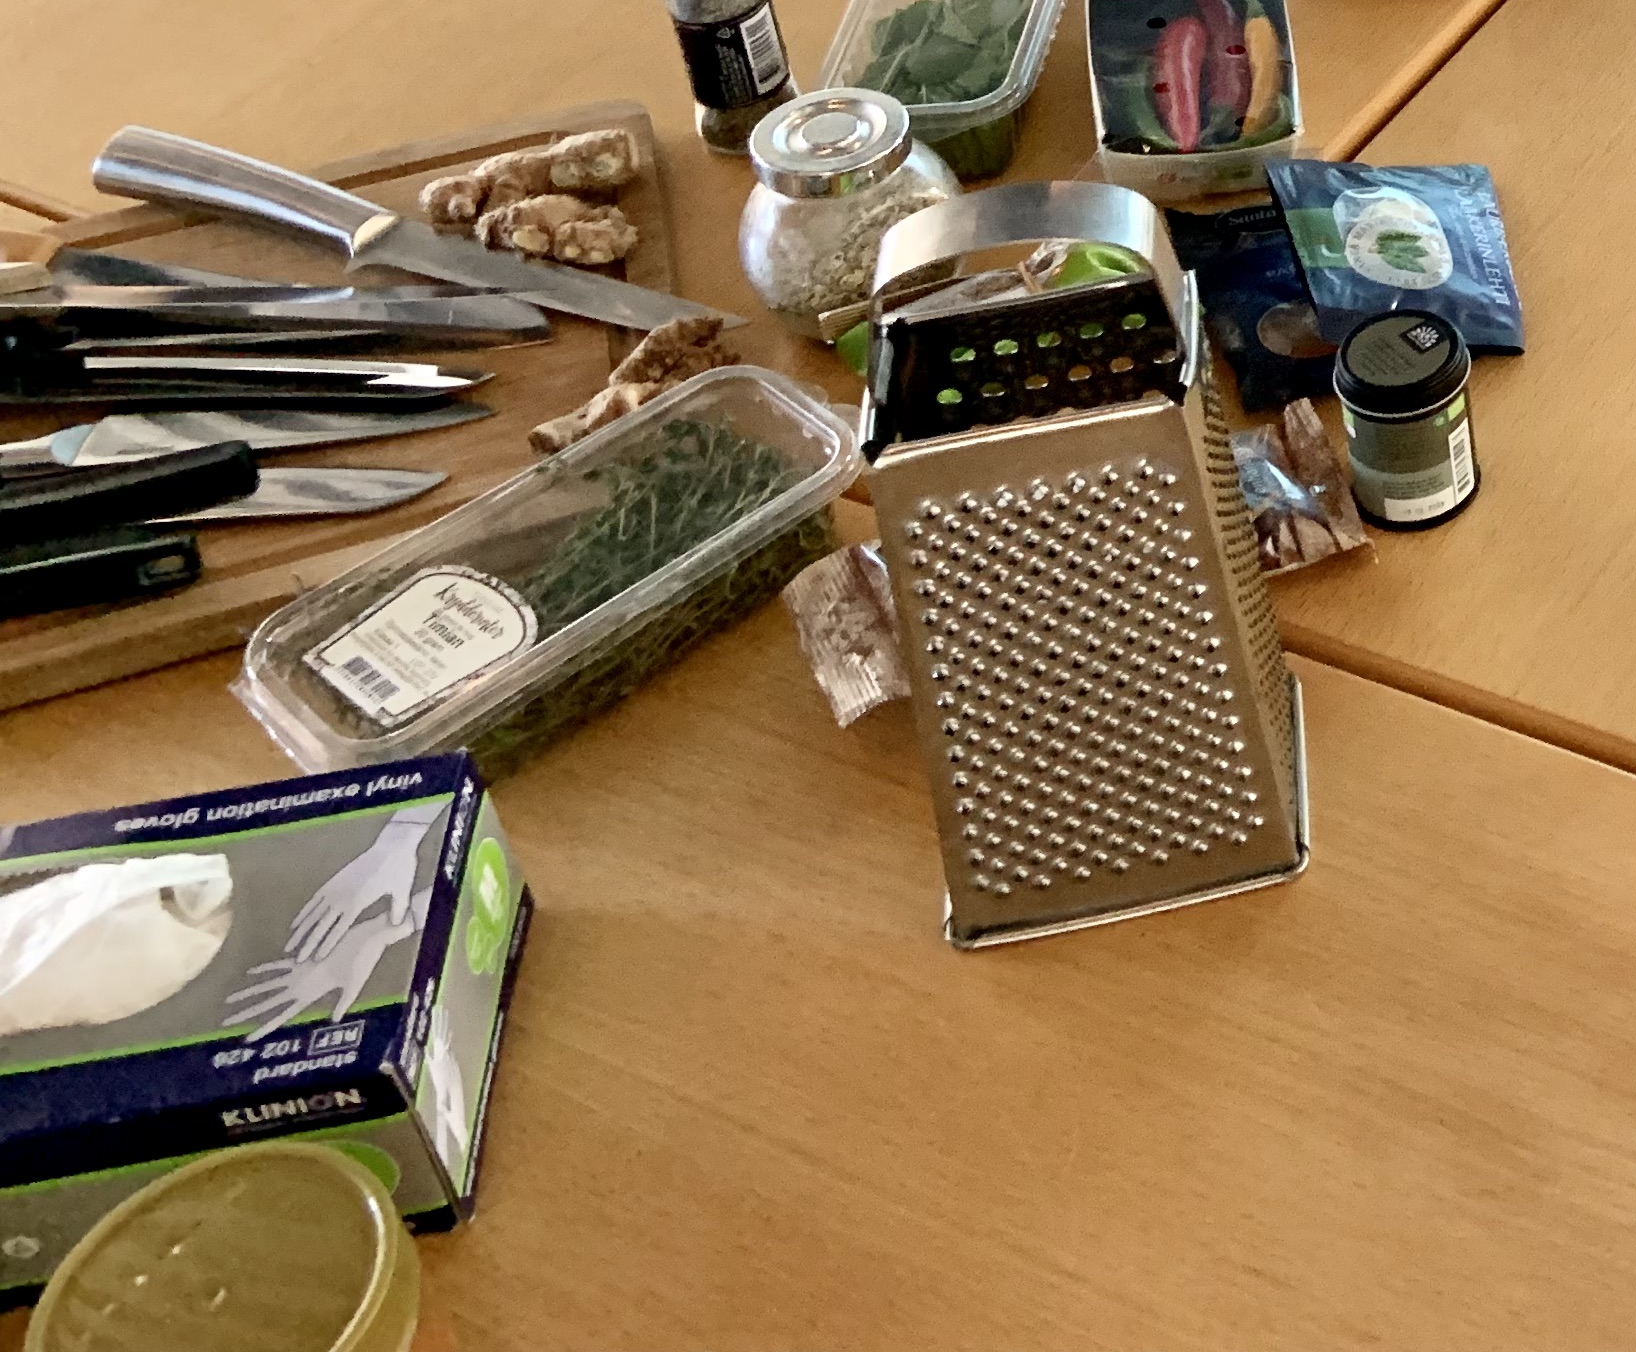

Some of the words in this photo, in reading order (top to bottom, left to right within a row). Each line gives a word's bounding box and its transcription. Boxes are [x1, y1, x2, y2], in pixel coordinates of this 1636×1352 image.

[366, 772, 423, 798] vinyl
[206, 782, 360, 820] examination
[114, 805, 202, 832] gloves
[260, 1039, 302, 1059] 102
[314, 1027, 359, 1049] REF
[253, 1050, 359, 1085] standard
